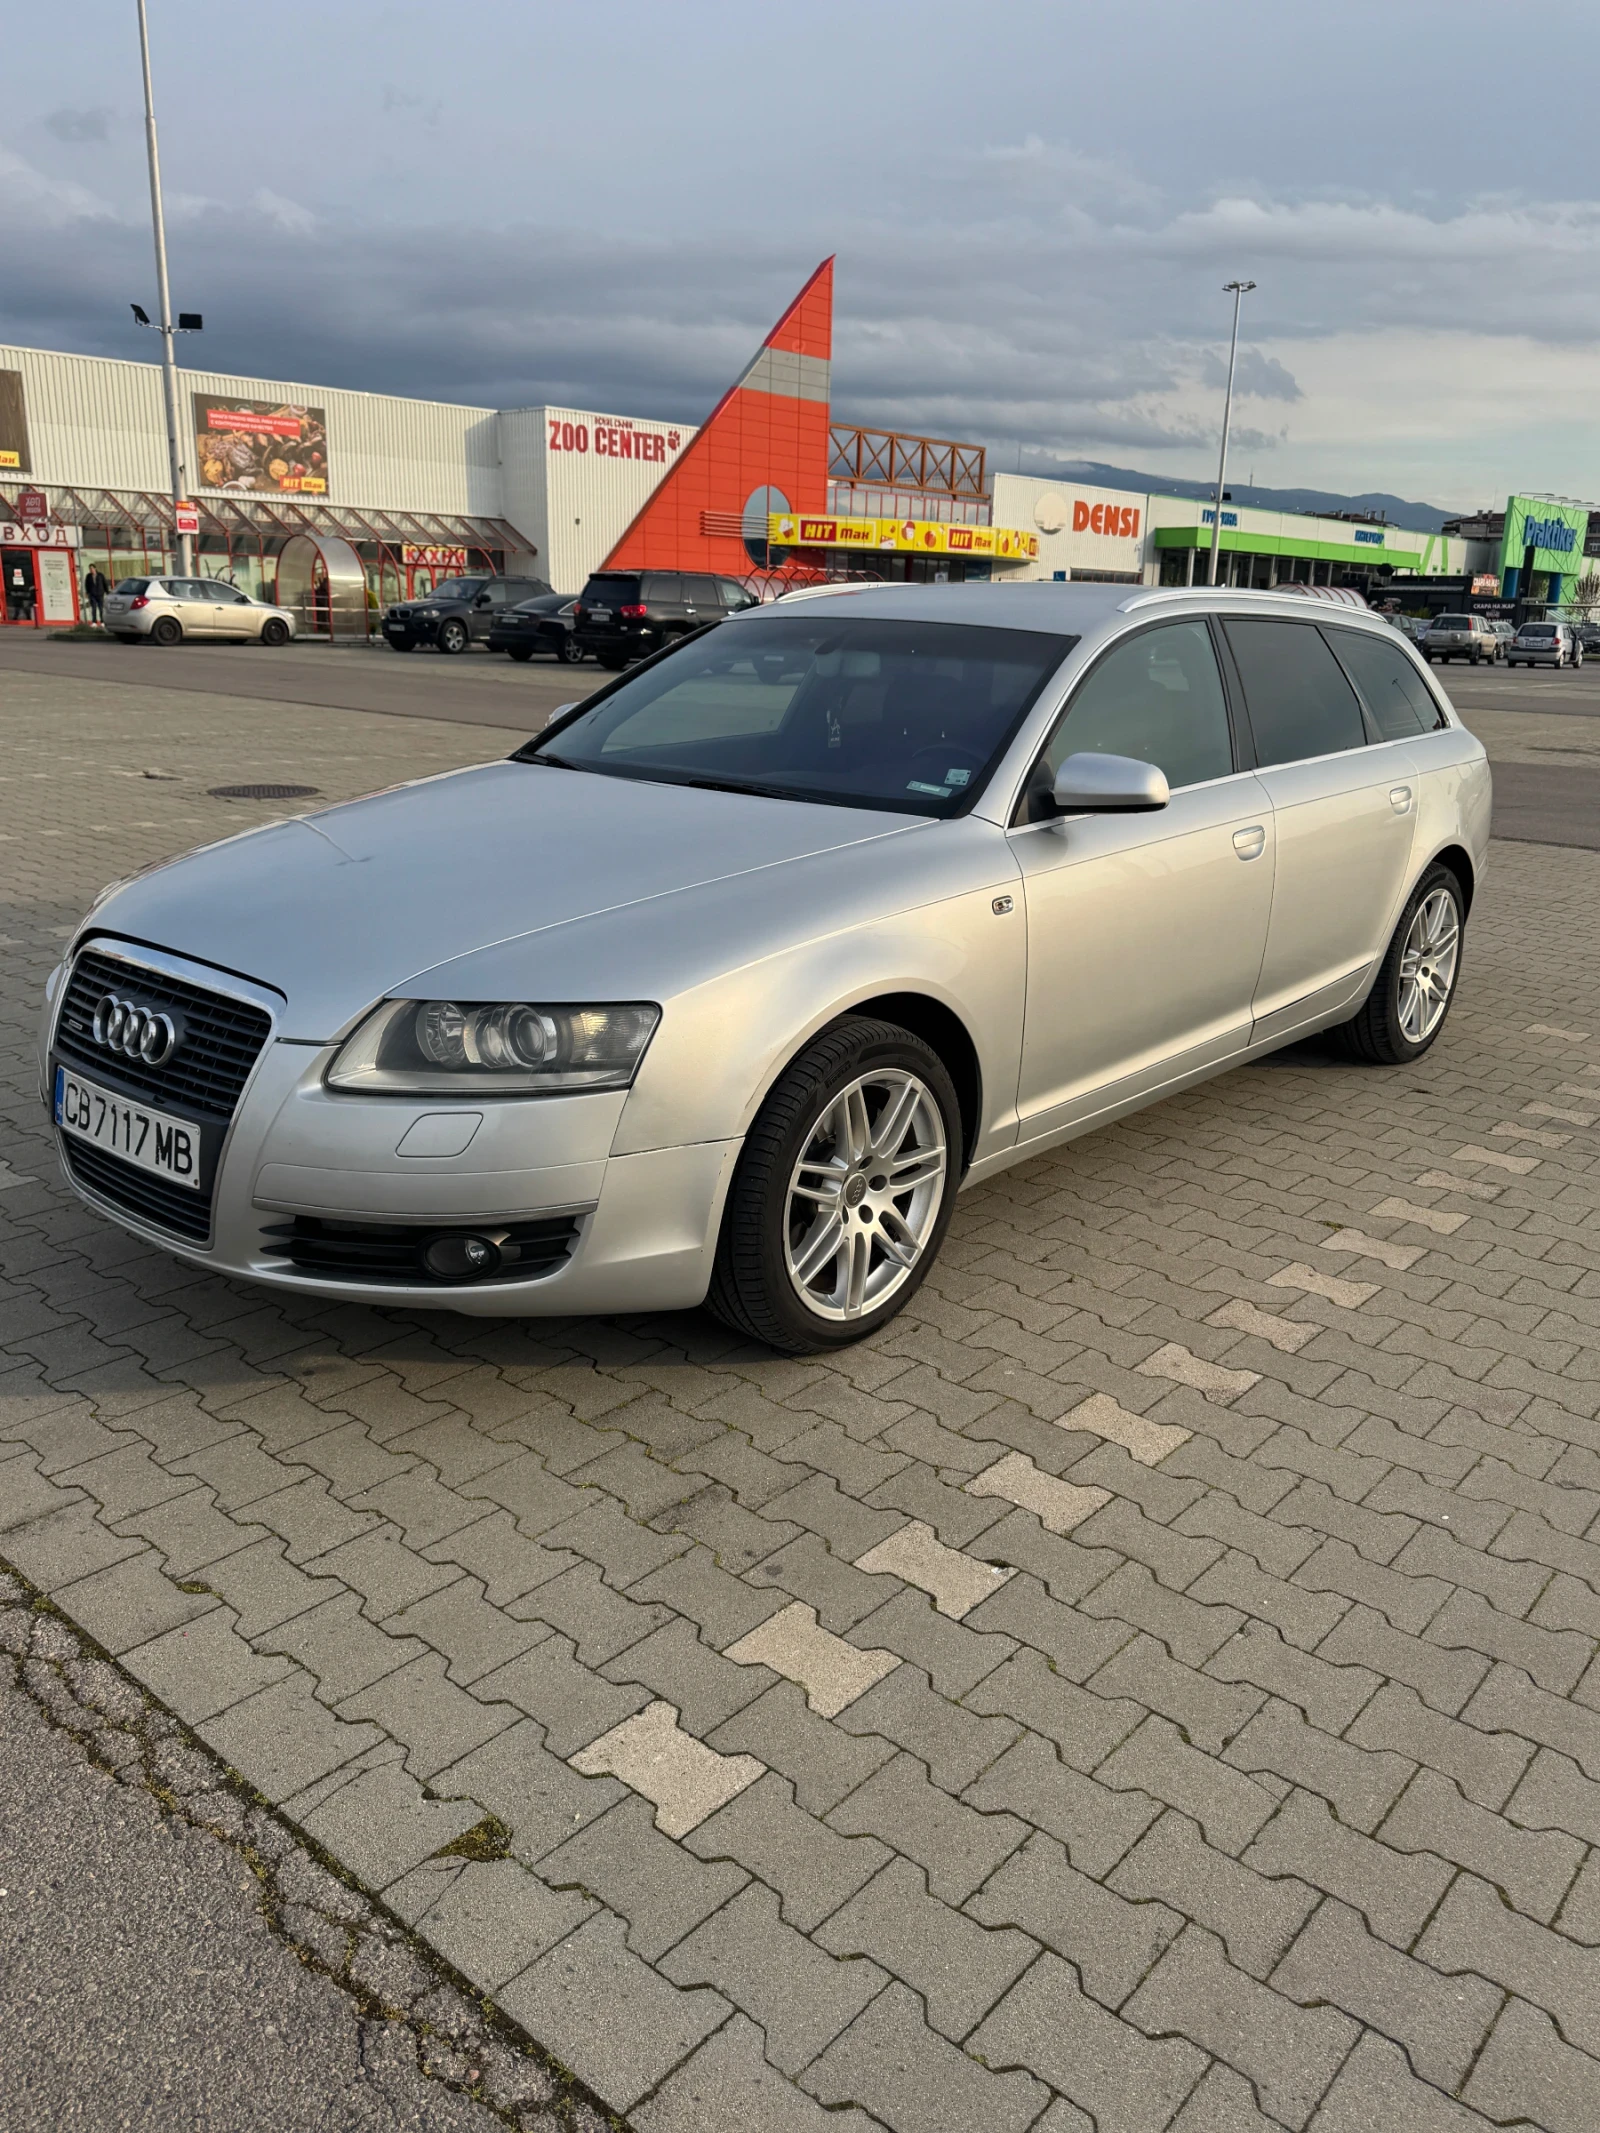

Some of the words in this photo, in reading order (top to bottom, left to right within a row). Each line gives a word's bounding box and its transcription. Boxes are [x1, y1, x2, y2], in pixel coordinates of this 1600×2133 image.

[548, 419, 589, 453] ZOO
[595, 426, 666, 463] CENTER
[283, 477, 300, 488] HIT
[1072, 500, 1140, 538] DENSI
[3, 526, 68, 546] ВХОД
[804, 523, 833, 539] HIT
[951, 532, 970, 547] HIT
[1522, 514, 1577, 552] Praktiker
